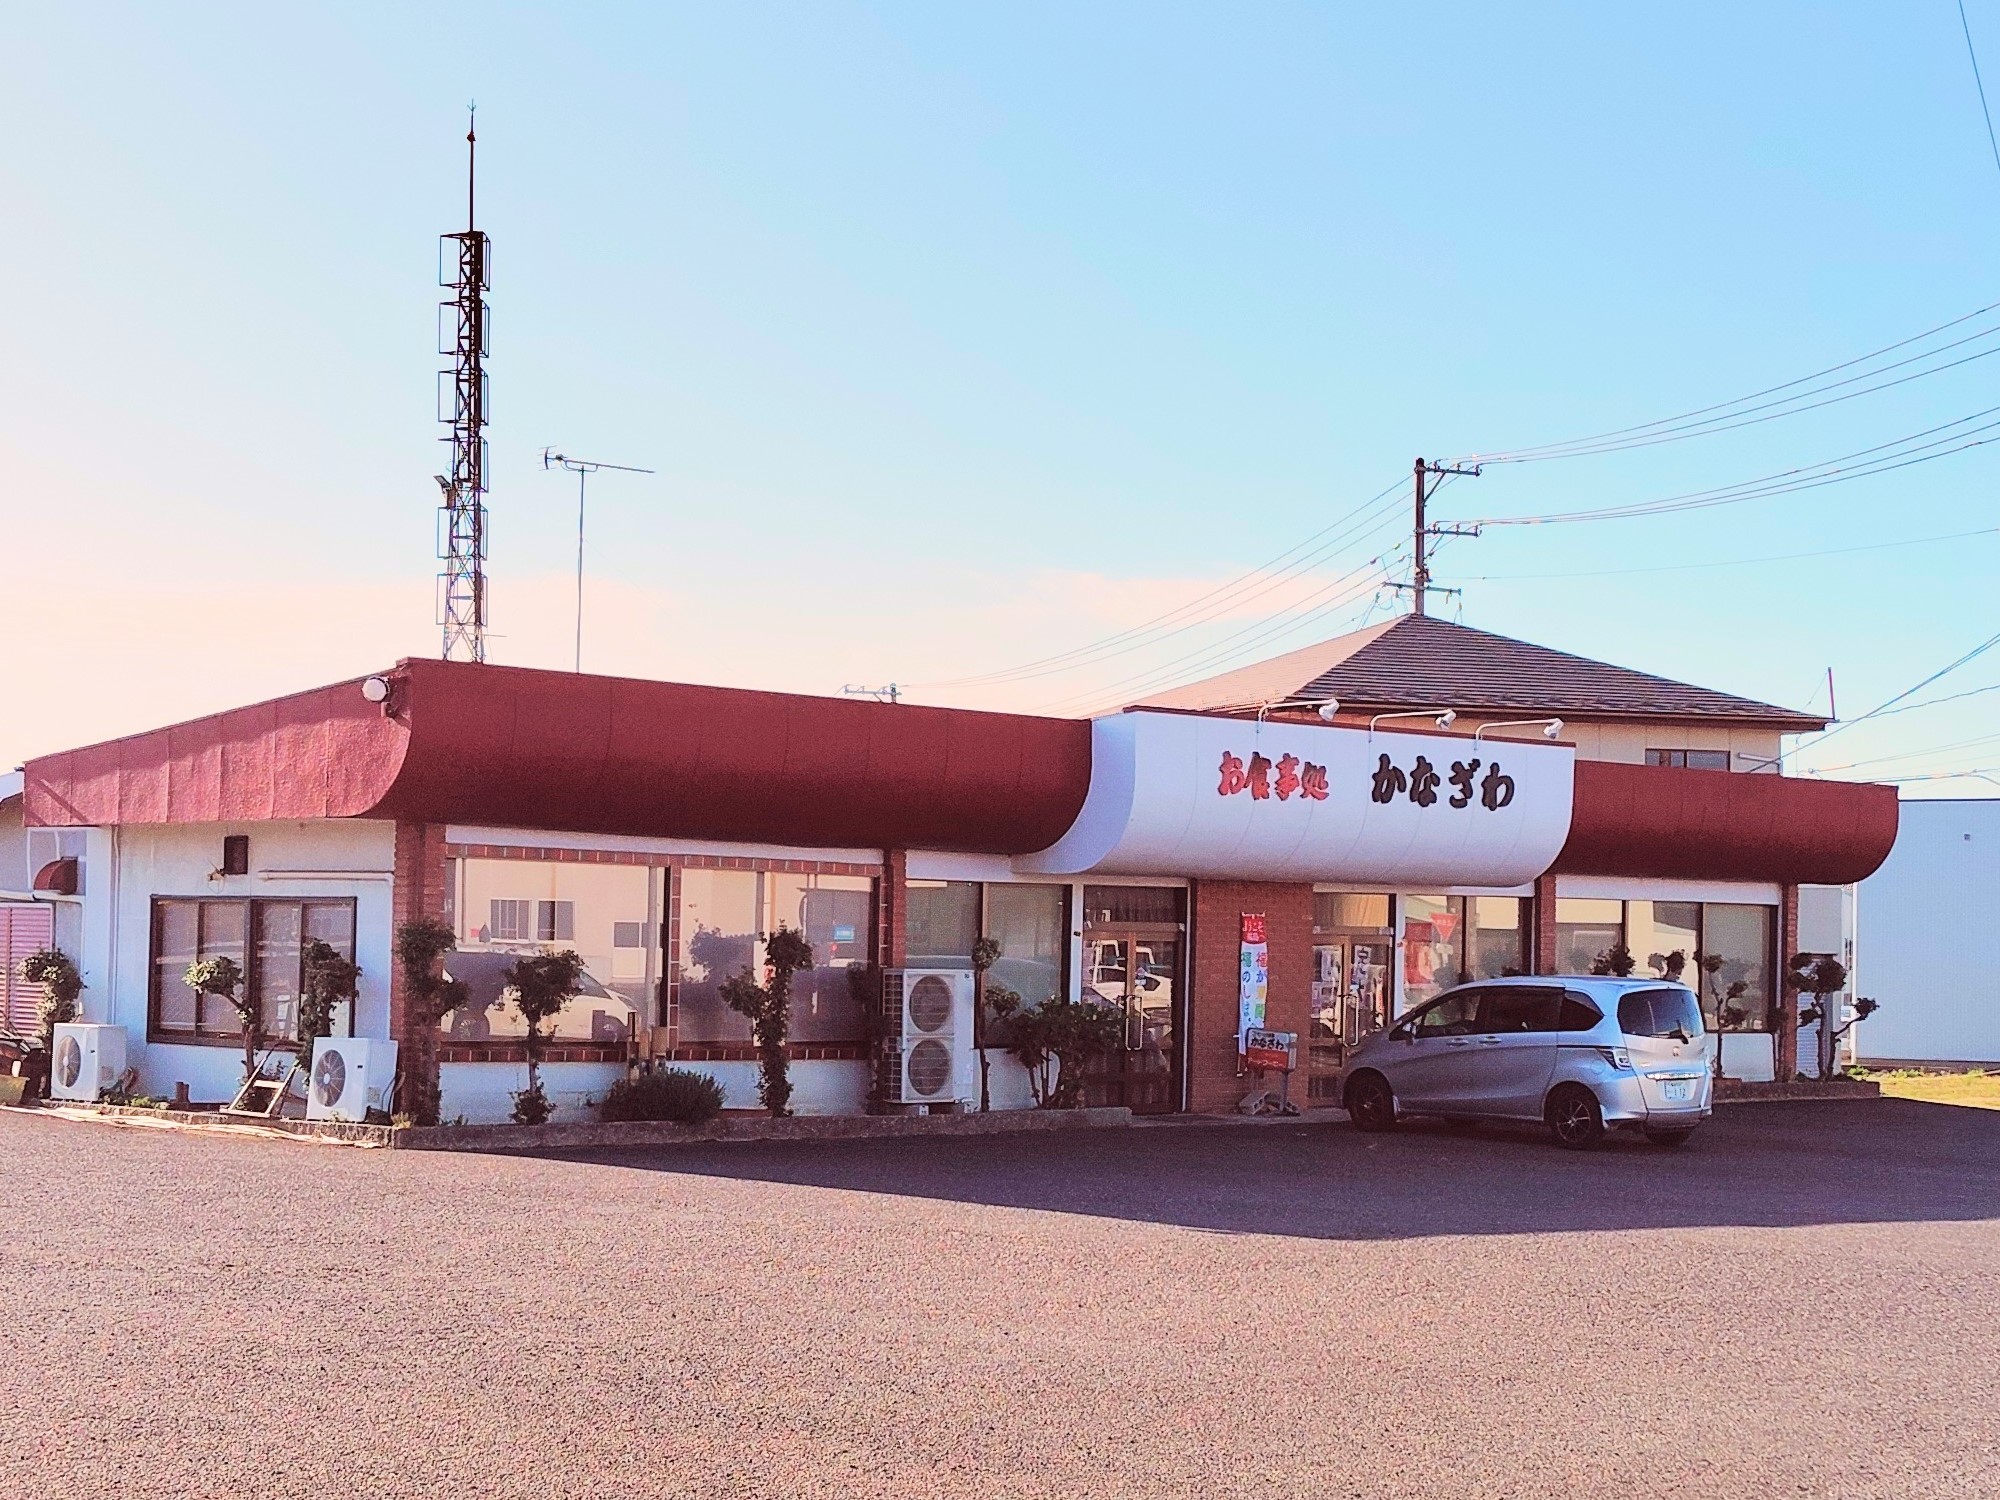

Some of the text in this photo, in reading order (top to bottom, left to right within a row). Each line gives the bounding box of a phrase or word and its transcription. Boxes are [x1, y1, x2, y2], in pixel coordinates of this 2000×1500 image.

[1217, 750, 1330, 801] お食事処
[1371, 753, 1515, 811] かなざわ
